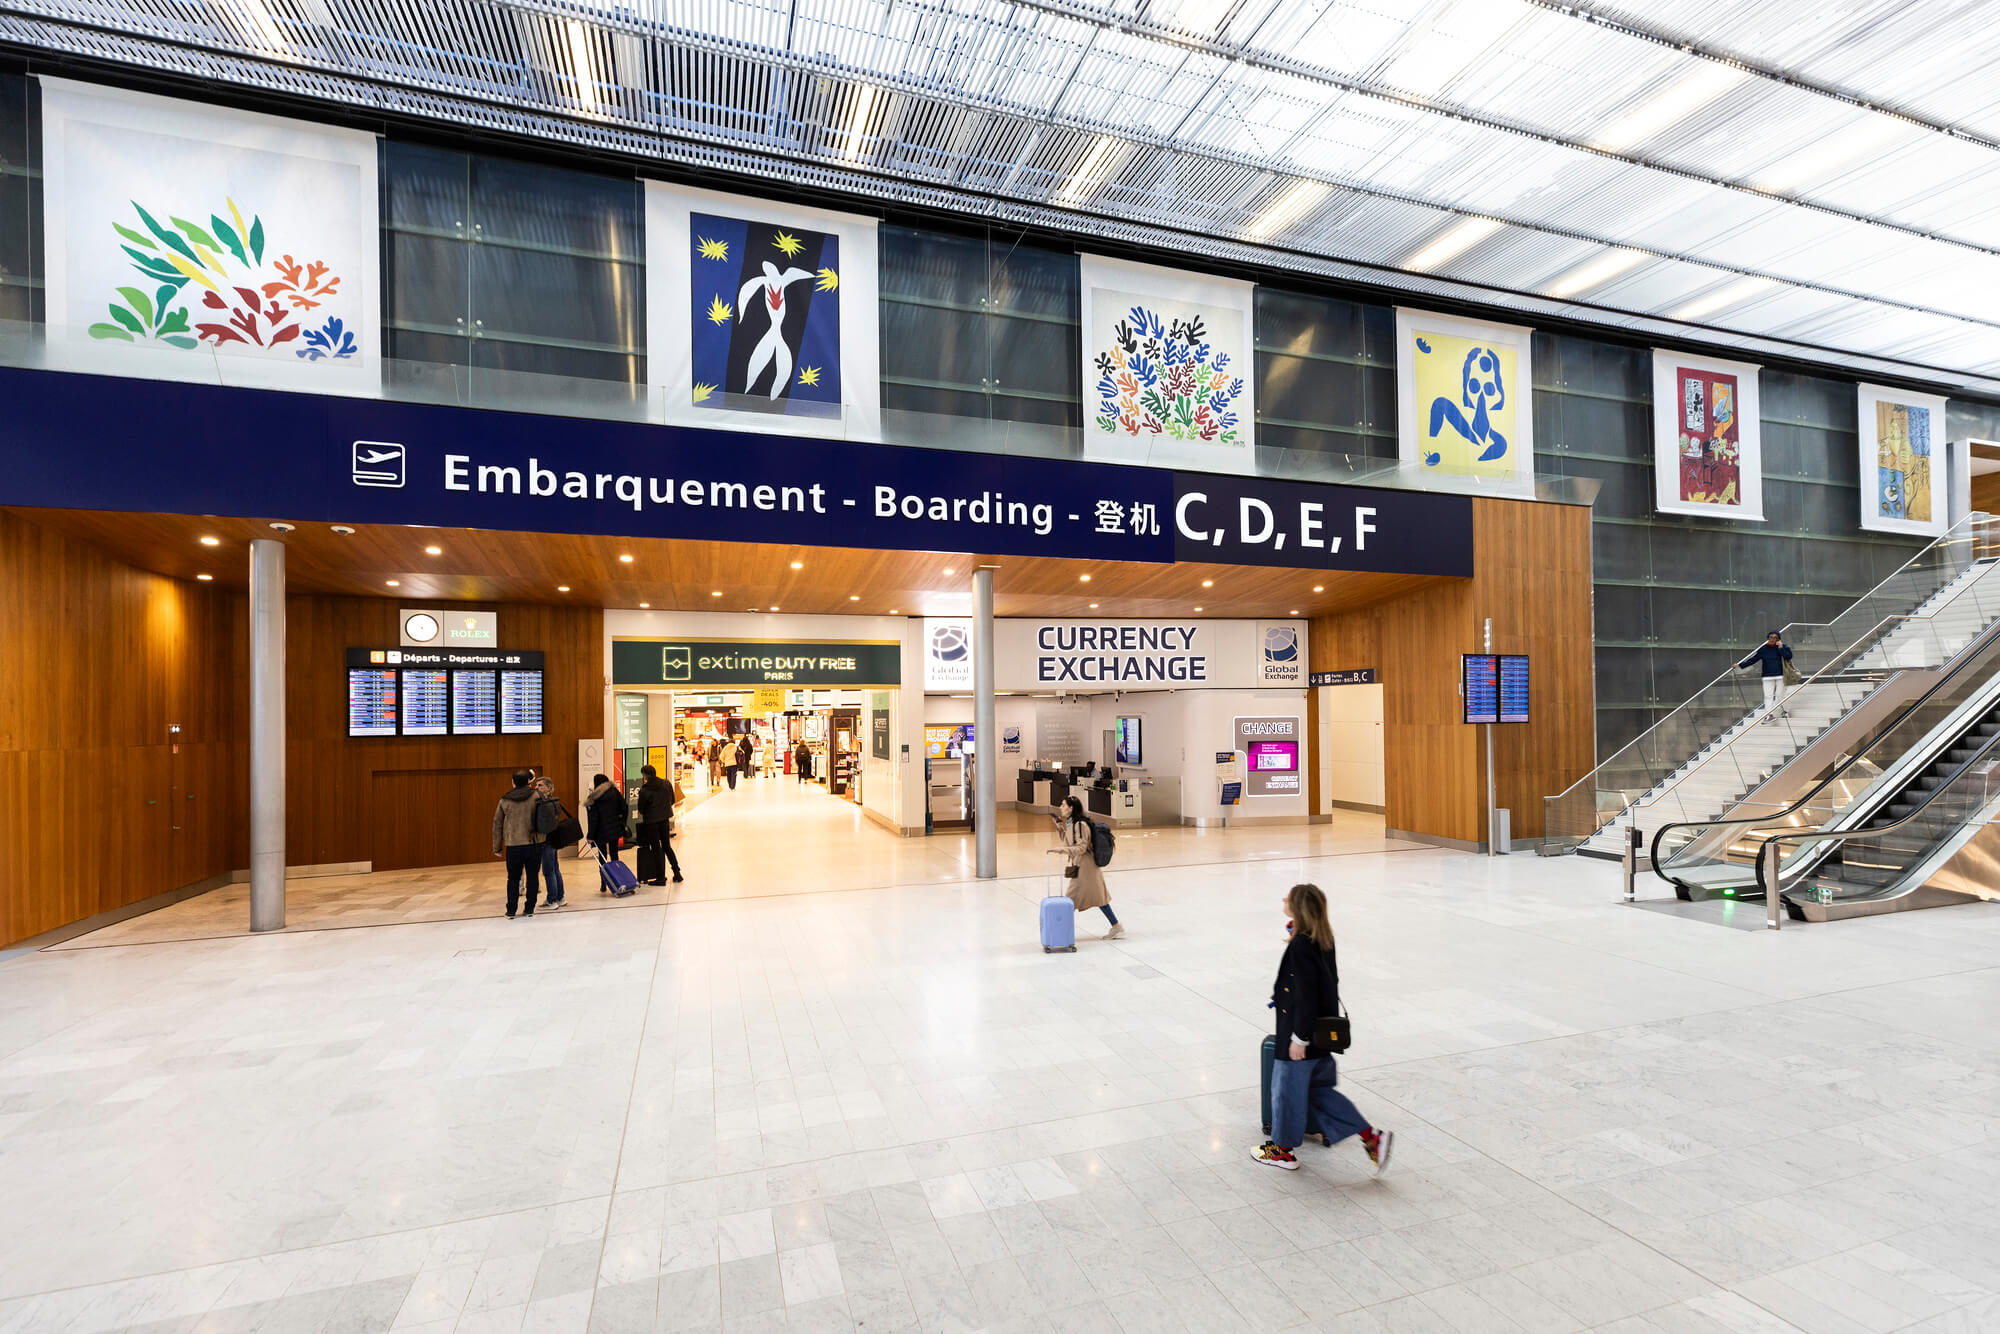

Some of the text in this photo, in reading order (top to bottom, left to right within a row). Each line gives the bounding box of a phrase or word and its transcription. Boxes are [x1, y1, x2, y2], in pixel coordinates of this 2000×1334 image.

[444, 454, 827, 517] Embarquement
[875, 485, 1054, 536] Boarding
[1094, 498, 1162, 537] 登机
[1175, 491, 1225, 547] C,
[1239, 497, 1286, 550] D,
[1300, 501, 1342, 554] E,
[1355, 506, 1378, 551] F
[450, 630, 490, 639] ROLEX
[1037, 625, 1198, 652] CURRENCY
[403, 653, 441, 663] Départs
[449, 654, 499, 665] Departures
[698, 651, 857, 671] extime DUTY FREE
[1037, 655, 1207, 682] EXCHANGE
[1264, 665, 1299, 673] Global
[764, 671, 794, 681] PARIS
[1264, 673, 1299, 681] Exchange
[1241, 722, 1293, 735] CHANGE
